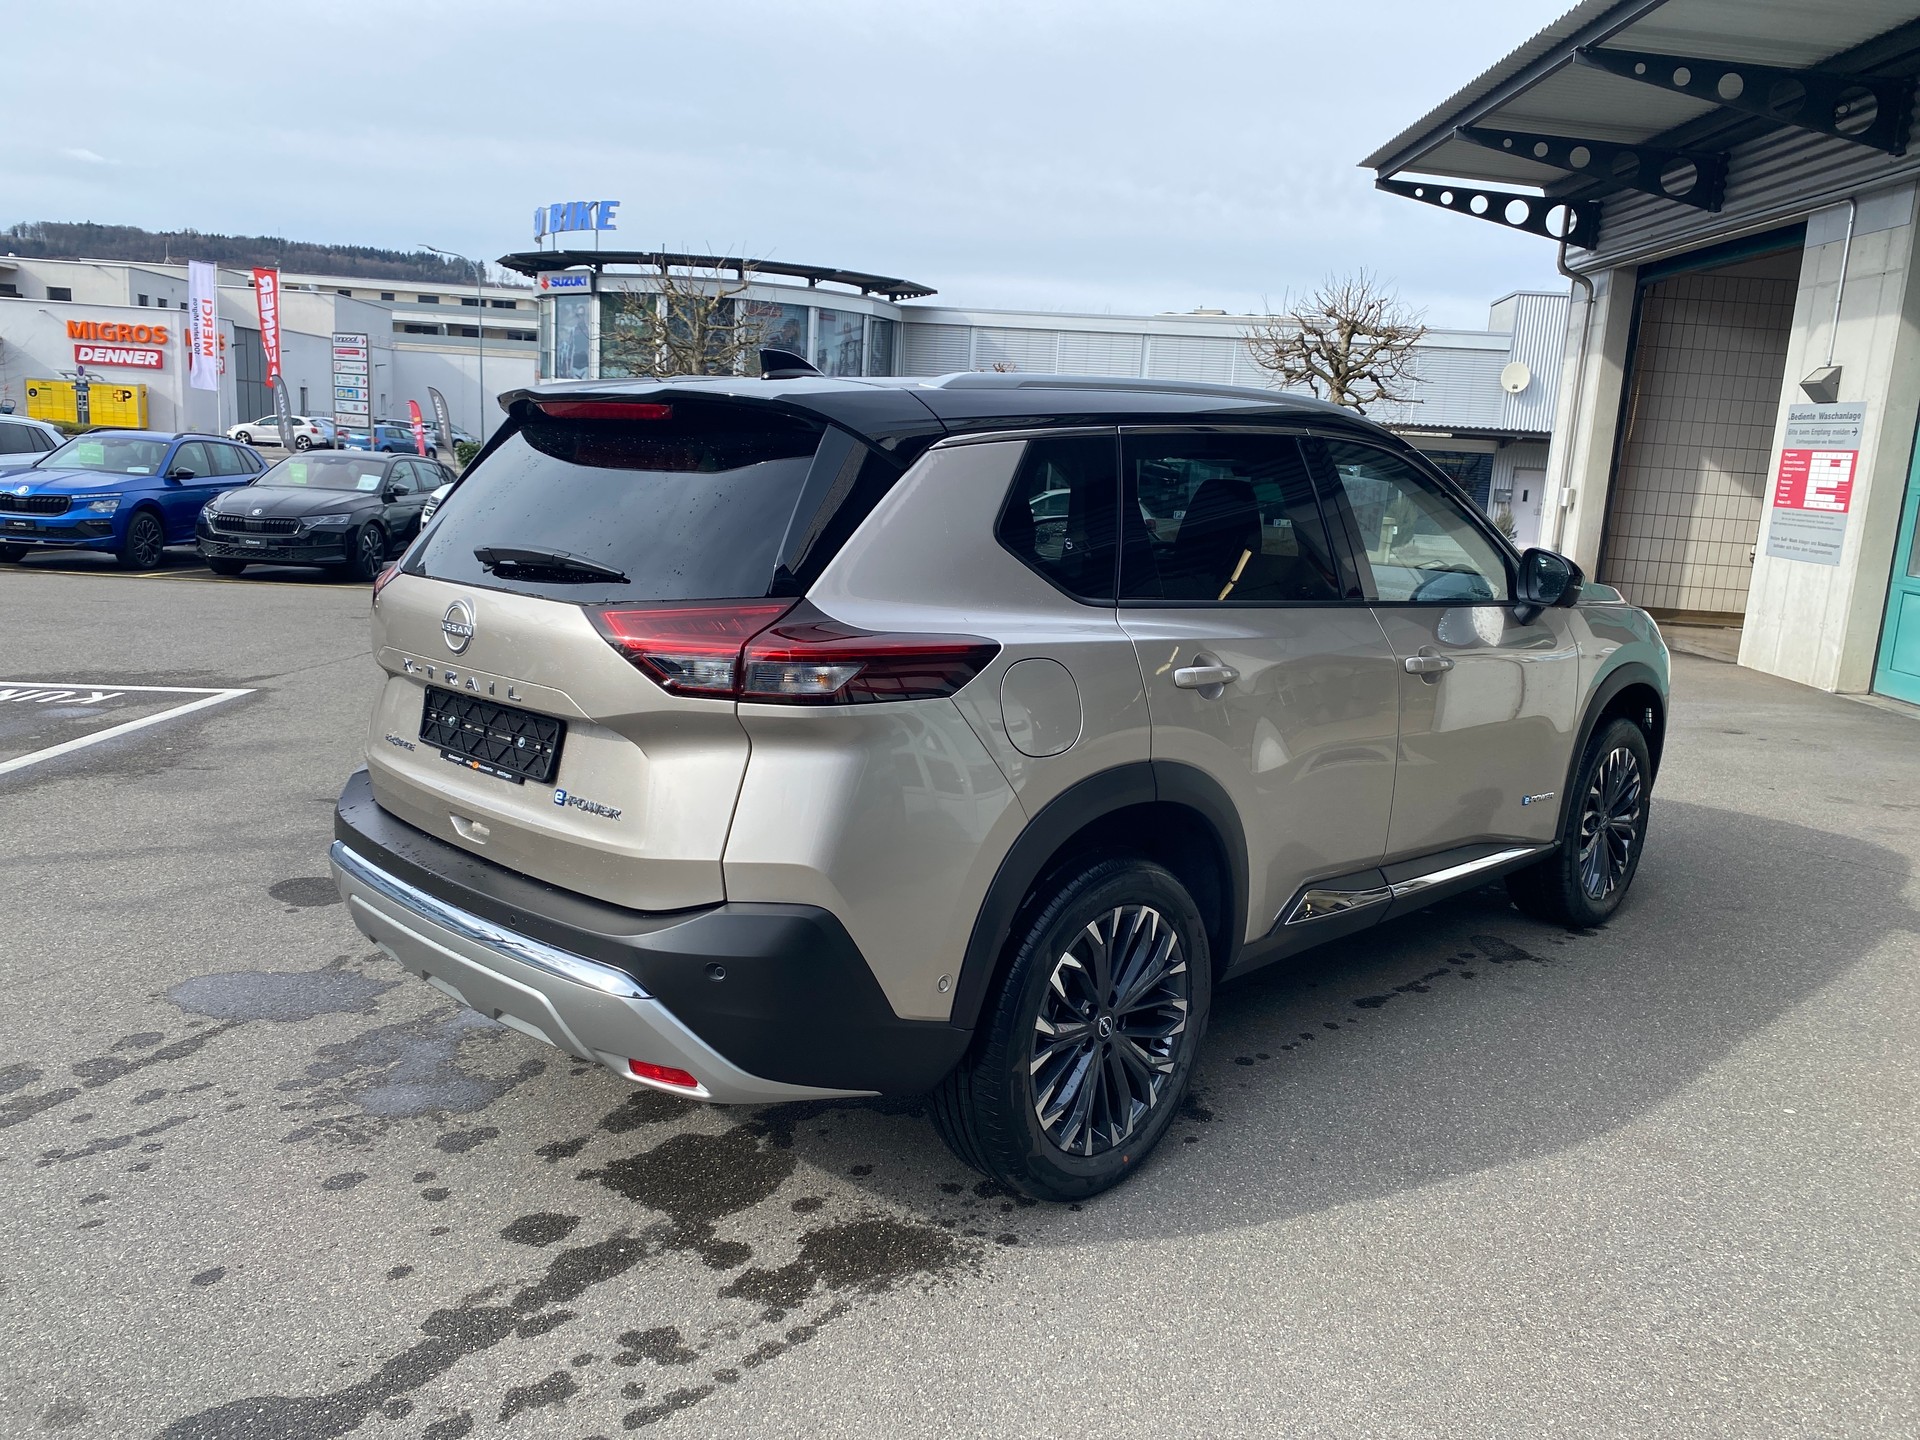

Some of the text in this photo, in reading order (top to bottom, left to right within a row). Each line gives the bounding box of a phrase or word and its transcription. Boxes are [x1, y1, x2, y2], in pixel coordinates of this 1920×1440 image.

[549, 201, 620, 232] BIKE
[551, 275, 587, 287] SUZUKI
[67, 320, 169, 345] MIGROS
[78, 347, 159, 366] DENNER
[1790, 411, 1862, 421] Bediente Waschanlage
[403, 658, 522, 702] X-TRAIL
